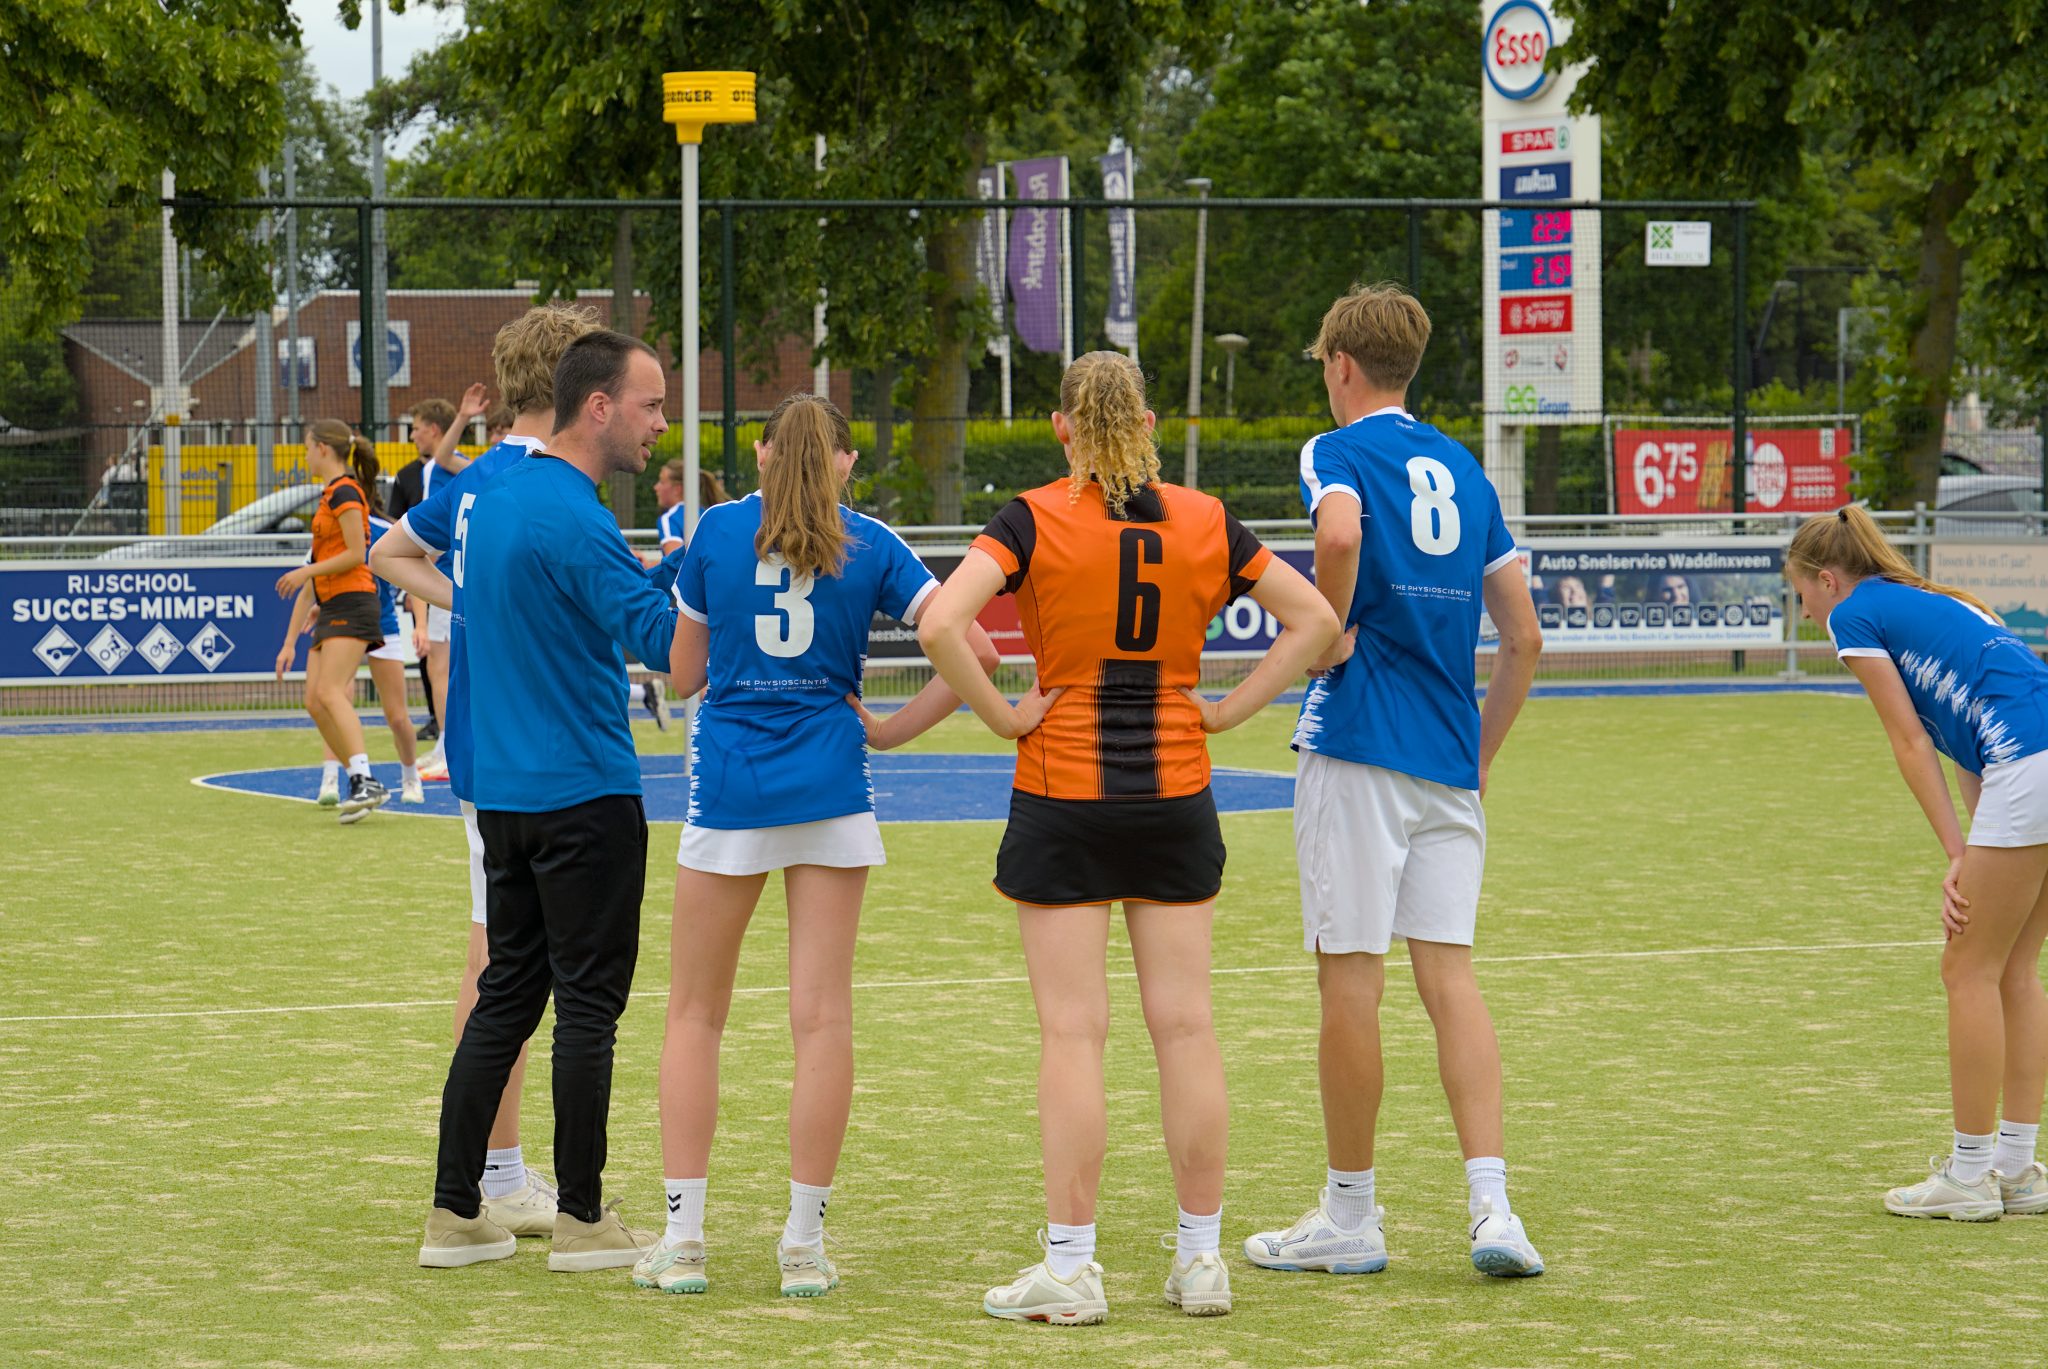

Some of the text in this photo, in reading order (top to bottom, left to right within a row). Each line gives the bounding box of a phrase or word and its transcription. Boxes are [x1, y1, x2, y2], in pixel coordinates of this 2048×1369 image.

[1495, 27, 1544, 66] Esso
[1512, 130, 1554, 151] SPAR
[1406, 456, 1460, 556] 8
[1539, 554, 1577, 570] Auto
[1580, 554, 1666, 570] Snelservice
[1669, 553, 1771, 569] Waddinxveen
[68, 573, 196, 594] RIJSCHOOL
[1115, 528, 1163, 652] 6
[1408, 585, 1472, 597] PHYSIOSCIENTIS
[13, 595, 254, 622] SUCCES-MIMPEN
[755, 552, 814, 657] 3
